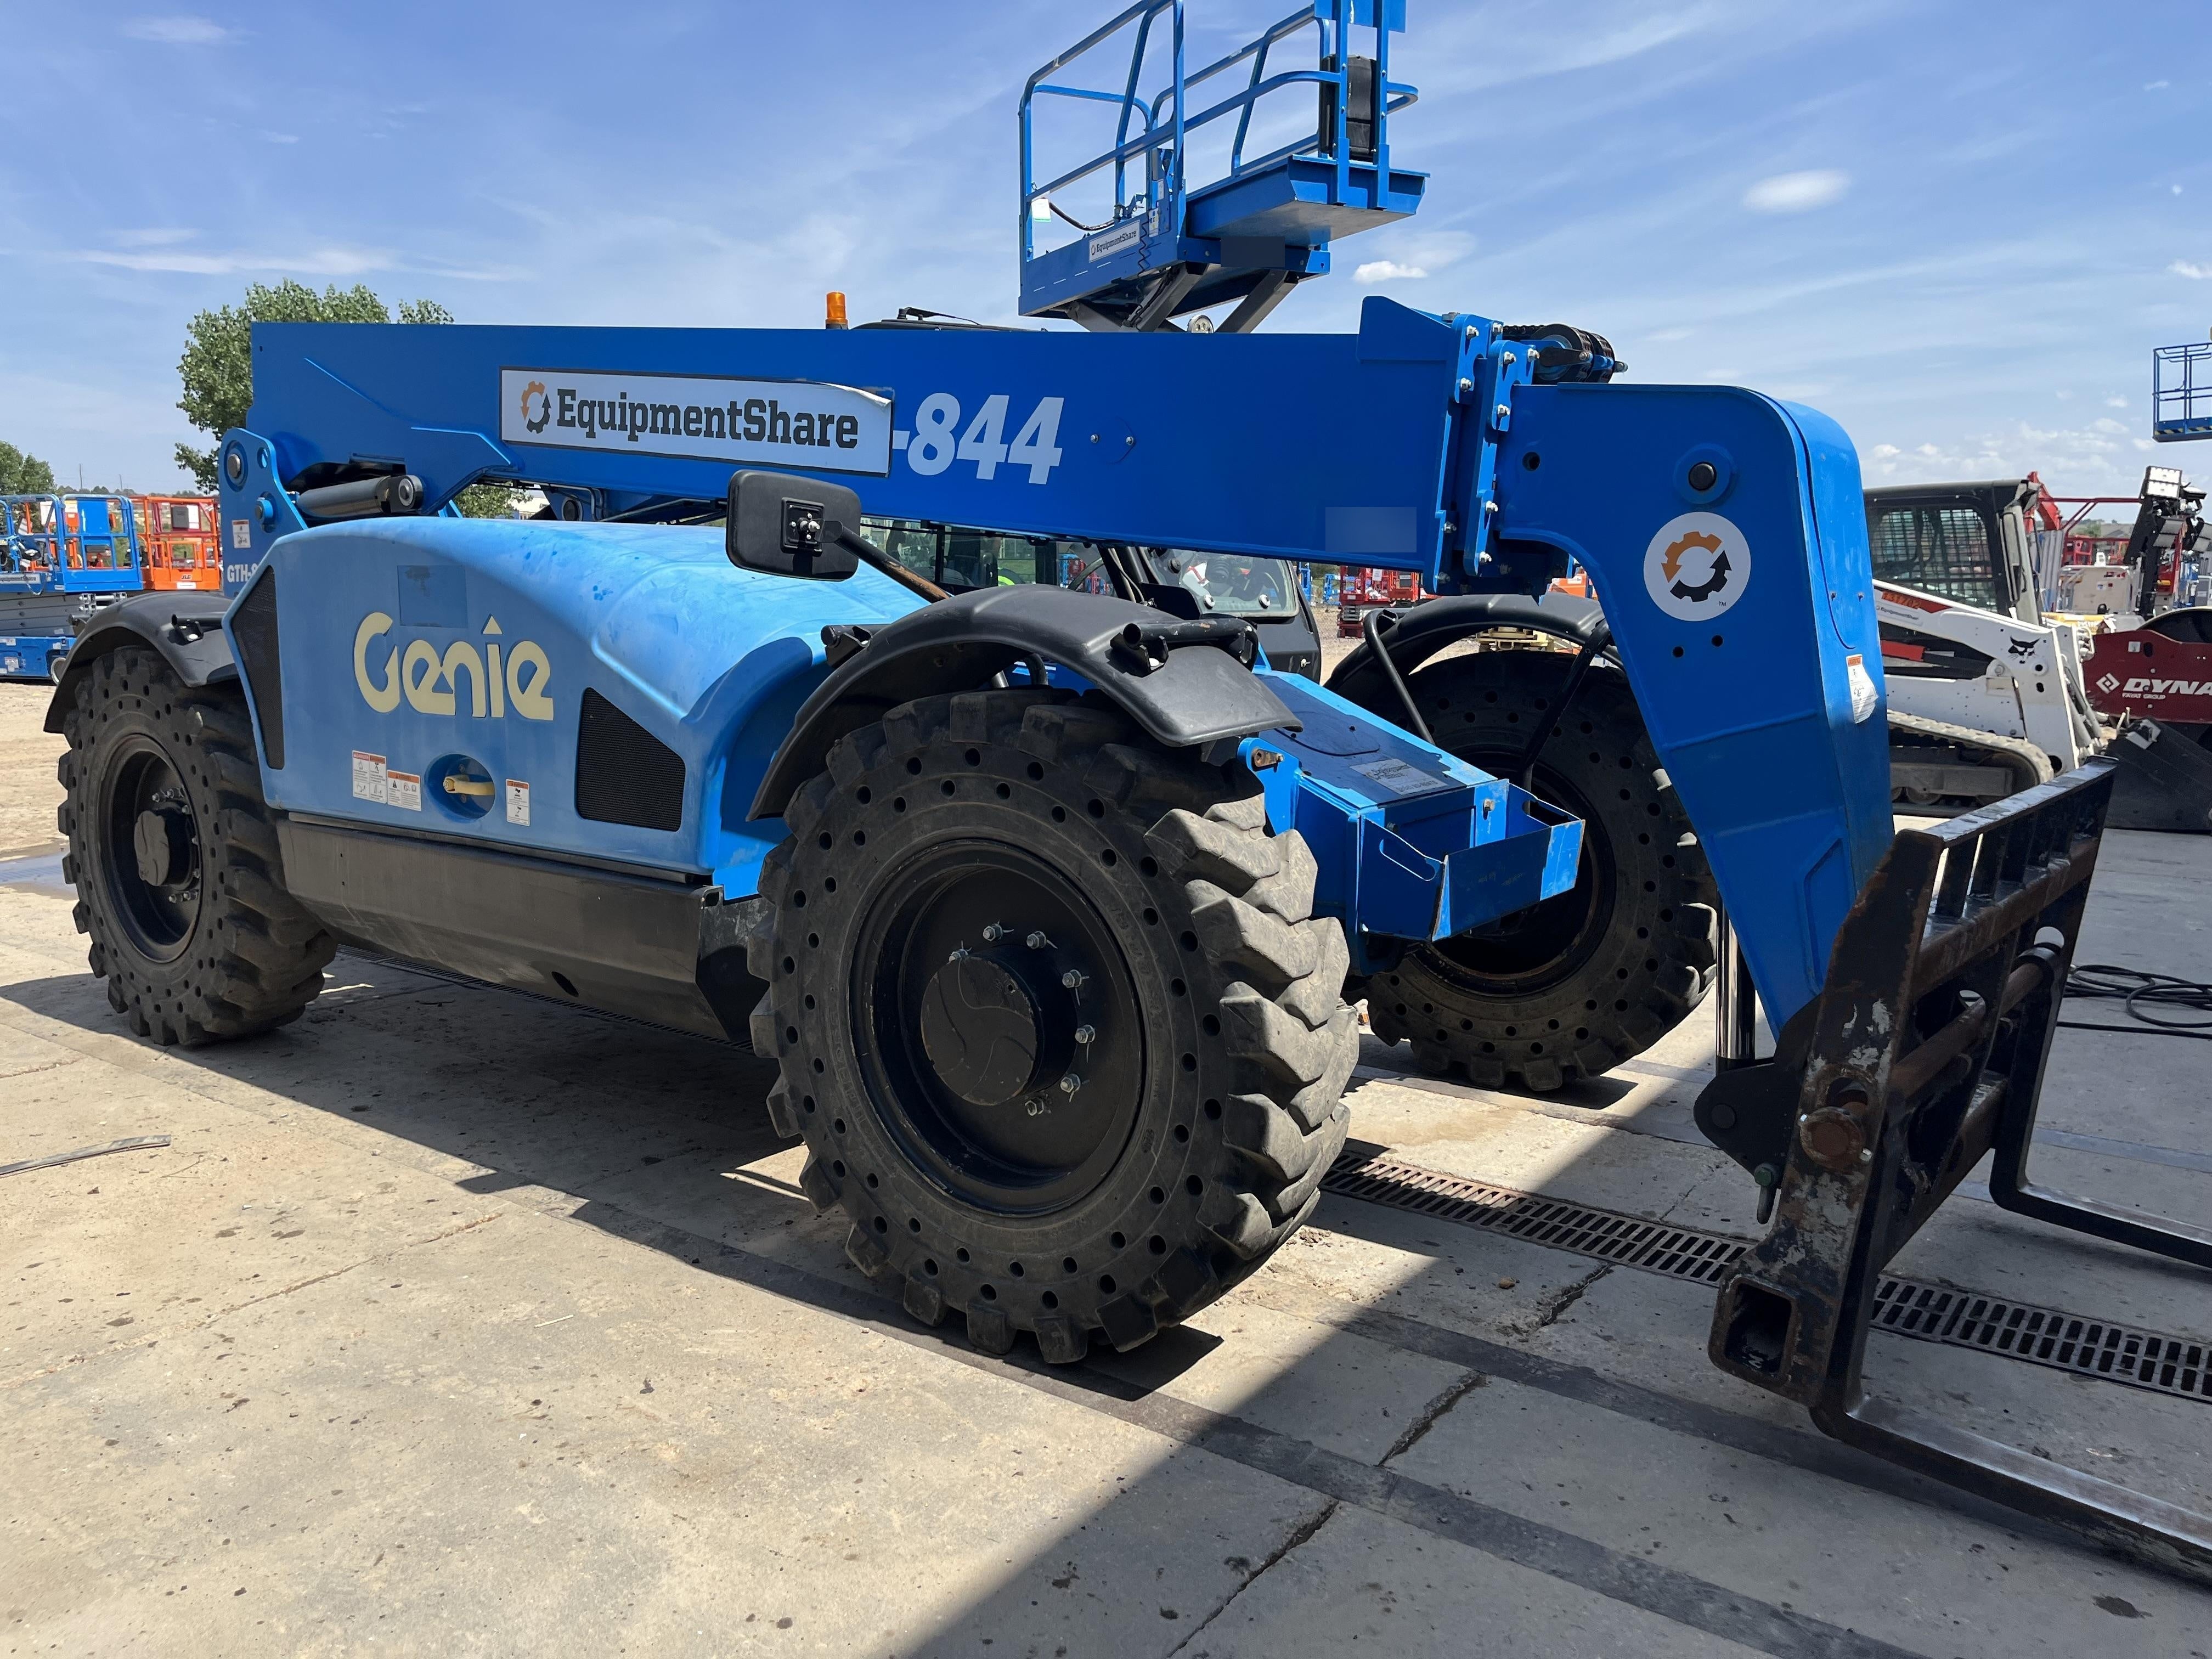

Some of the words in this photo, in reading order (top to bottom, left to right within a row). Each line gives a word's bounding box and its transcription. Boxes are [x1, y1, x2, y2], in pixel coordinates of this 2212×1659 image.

[1096, 230, 1137, 253] EquipmentShare
[557, 388, 859, 449] EquipmentShare
[354, 612, 554, 721] Genie
[2123, 678, 2212, 696] DYNA
